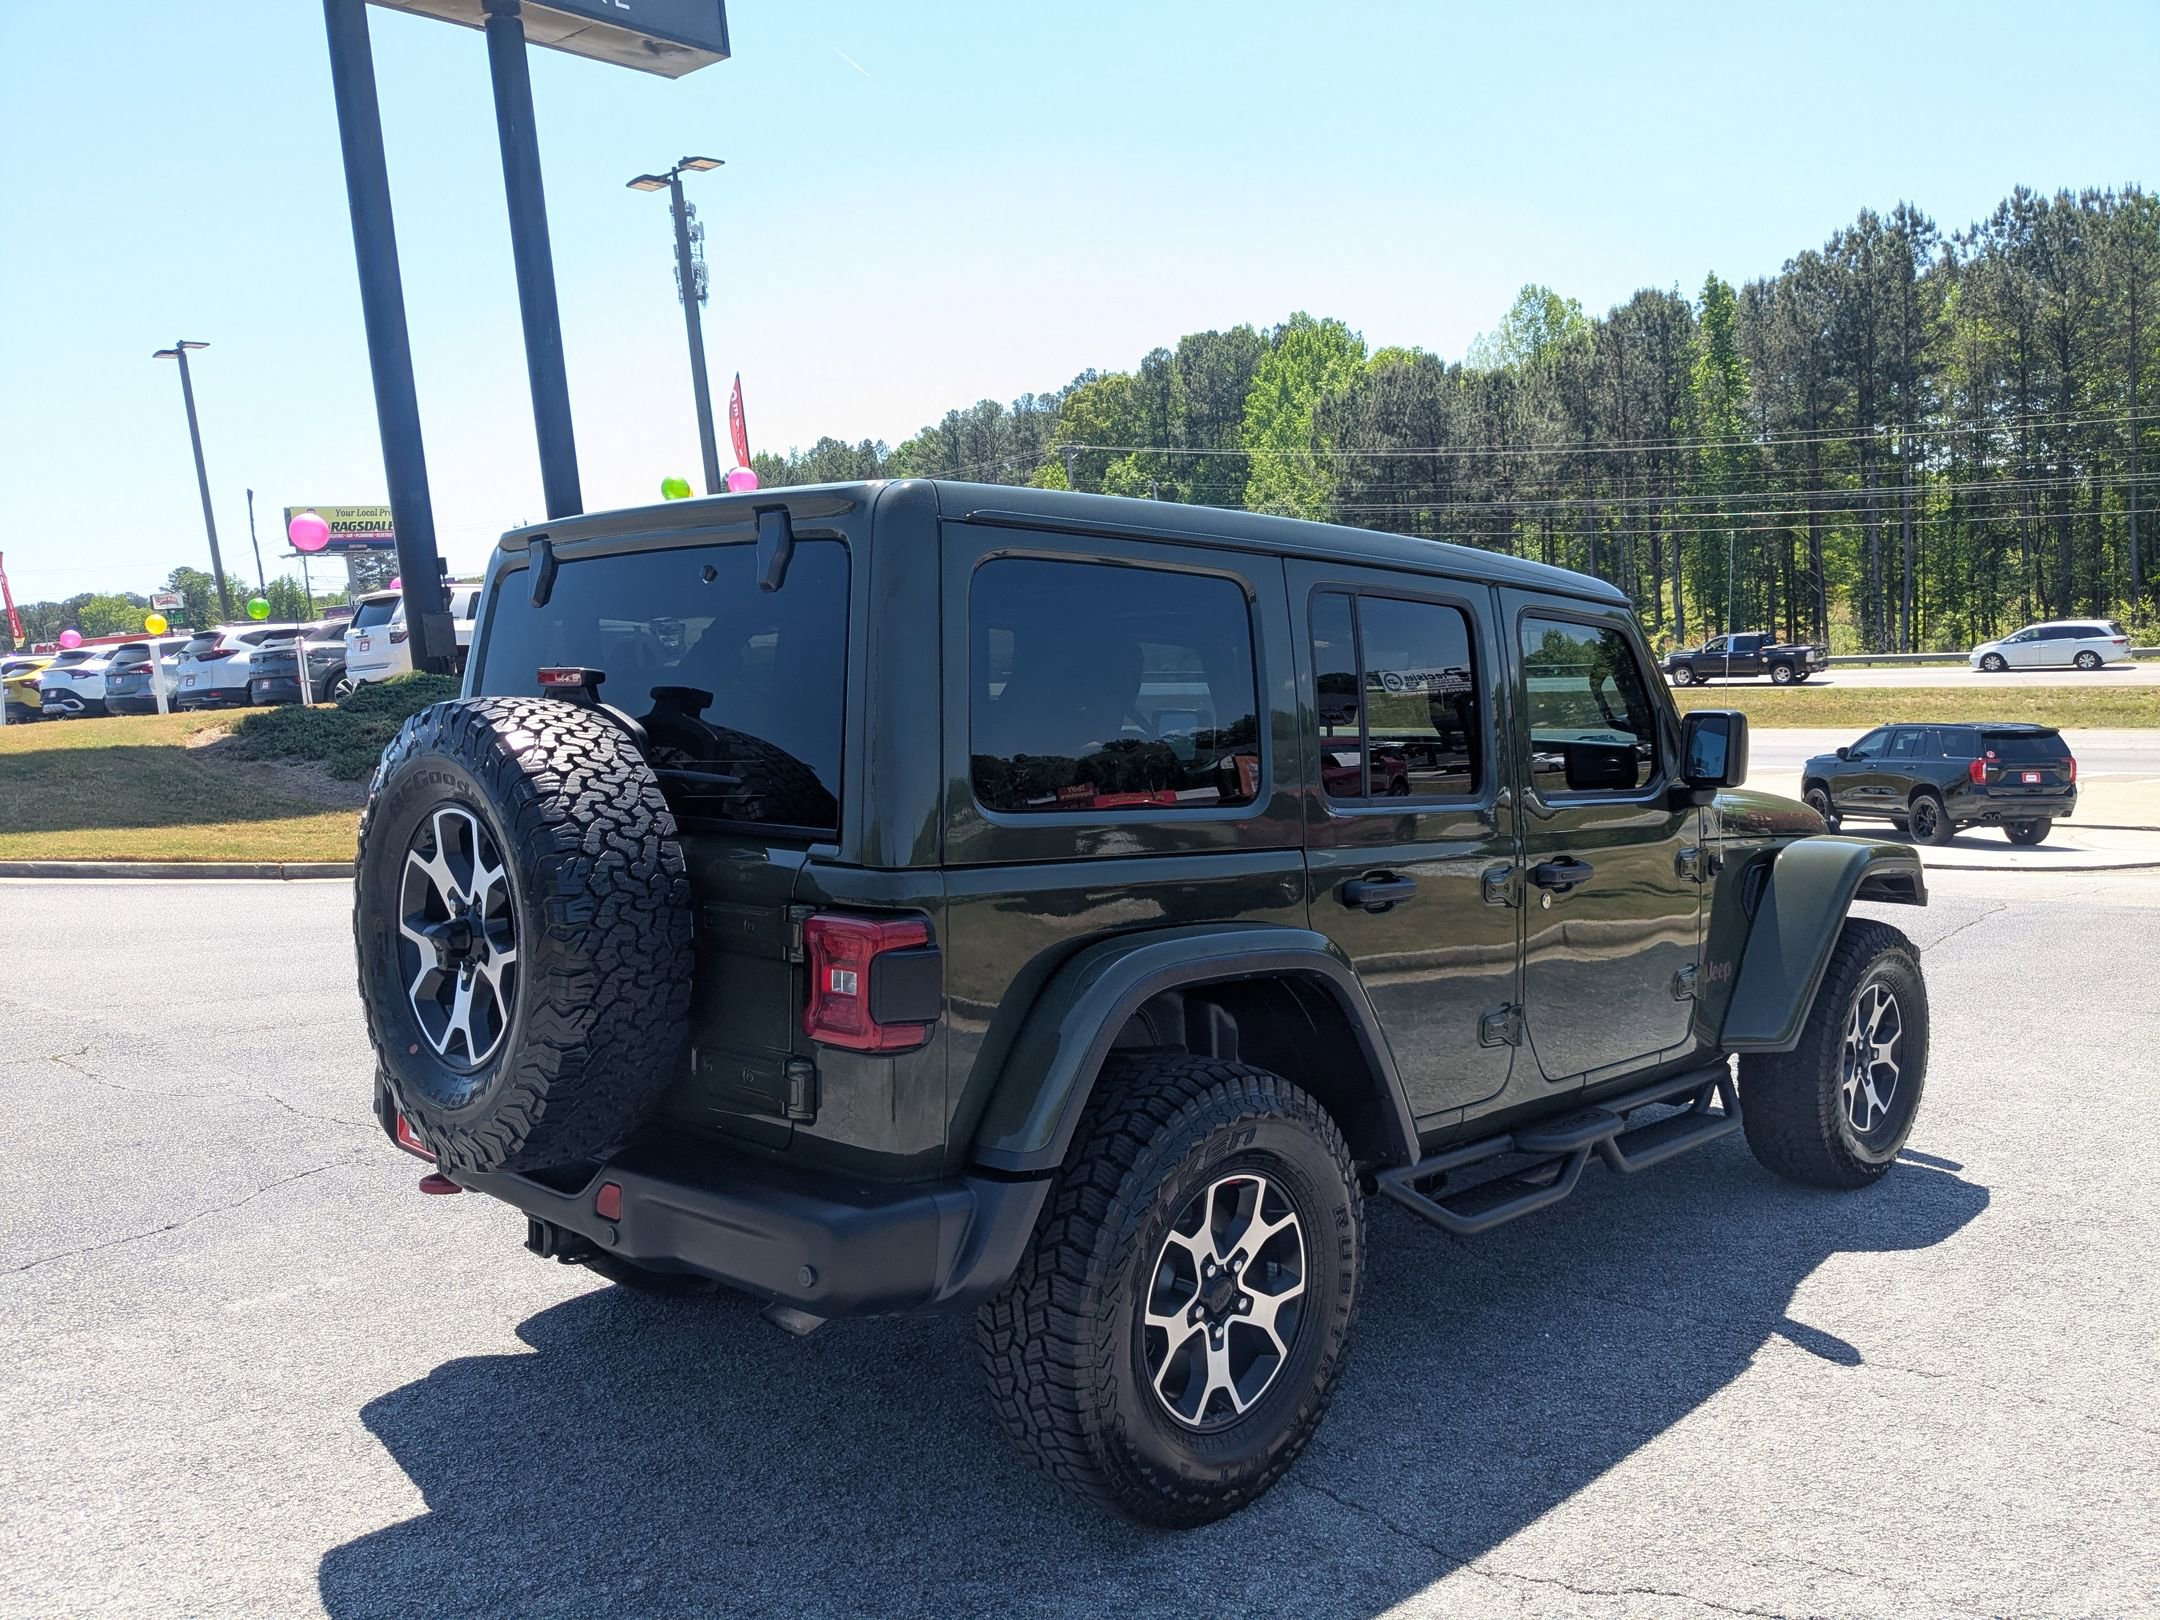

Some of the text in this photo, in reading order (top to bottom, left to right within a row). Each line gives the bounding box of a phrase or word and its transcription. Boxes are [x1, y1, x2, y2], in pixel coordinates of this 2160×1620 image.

[335, 508, 355, 517] Your
[356, 508, 378, 517] Local
[1705, 960, 1731, 983] Jeep
